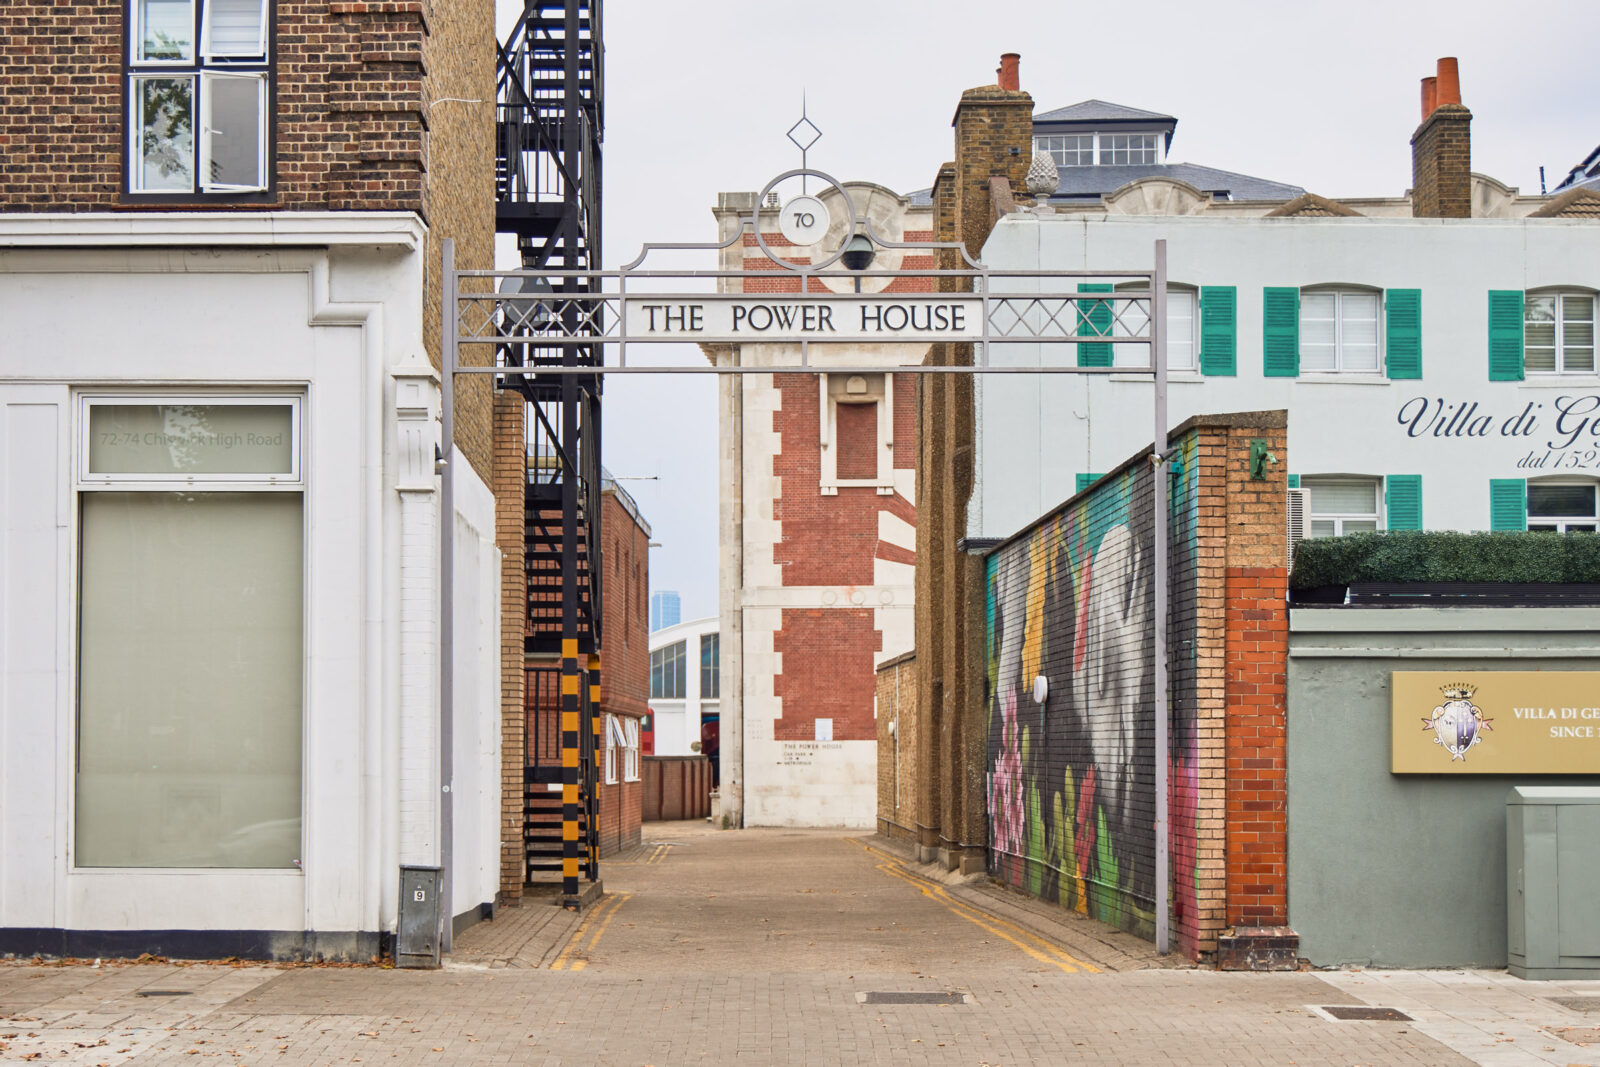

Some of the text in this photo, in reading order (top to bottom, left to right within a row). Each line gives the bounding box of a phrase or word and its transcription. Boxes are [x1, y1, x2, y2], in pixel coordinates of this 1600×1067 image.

[793, 212, 815, 228] 70
[642, 305, 966, 332] THE POWER HOUSE
[1397, 395, 1600, 450] Villa di Ge
[100, 431, 283, 449] 72-74 Chick High Road
[1517, 450, 1600, 469] dal 152
[1513, 707, 1558, 720] VILLA
[1561, 707, 1577, 720] DI
[1549, 726, 1594, 738] SINCE
[417, 892, 422, 900] 9
